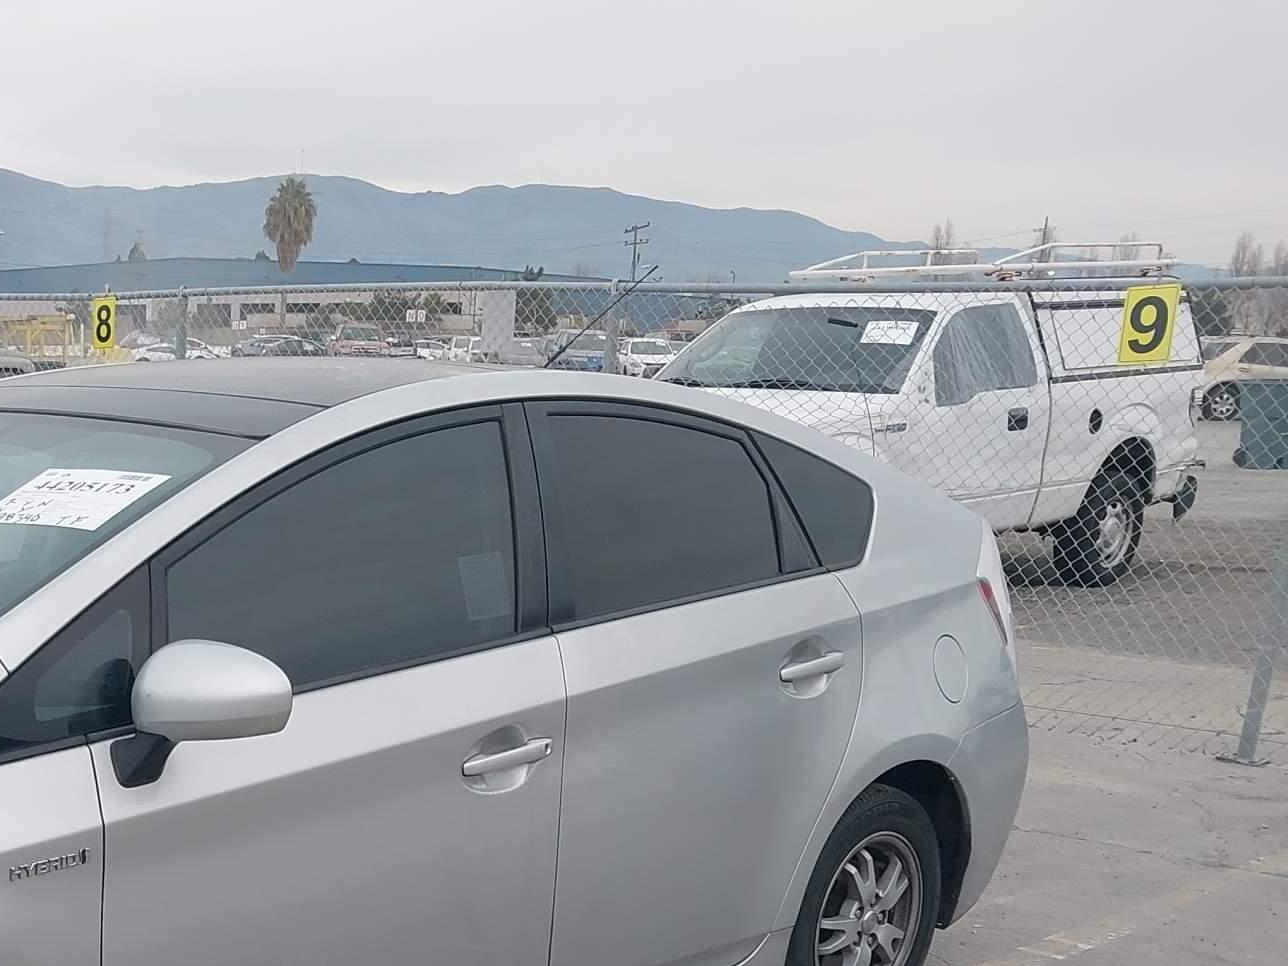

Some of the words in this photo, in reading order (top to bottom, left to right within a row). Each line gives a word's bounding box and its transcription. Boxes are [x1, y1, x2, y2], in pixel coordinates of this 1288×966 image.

[96, 304, 112, 343] 8
[1127, 295, 1169, 355] 9
[34, 480, 136, 495] 44205173
[8, 853, 78, 881] HYBRID
